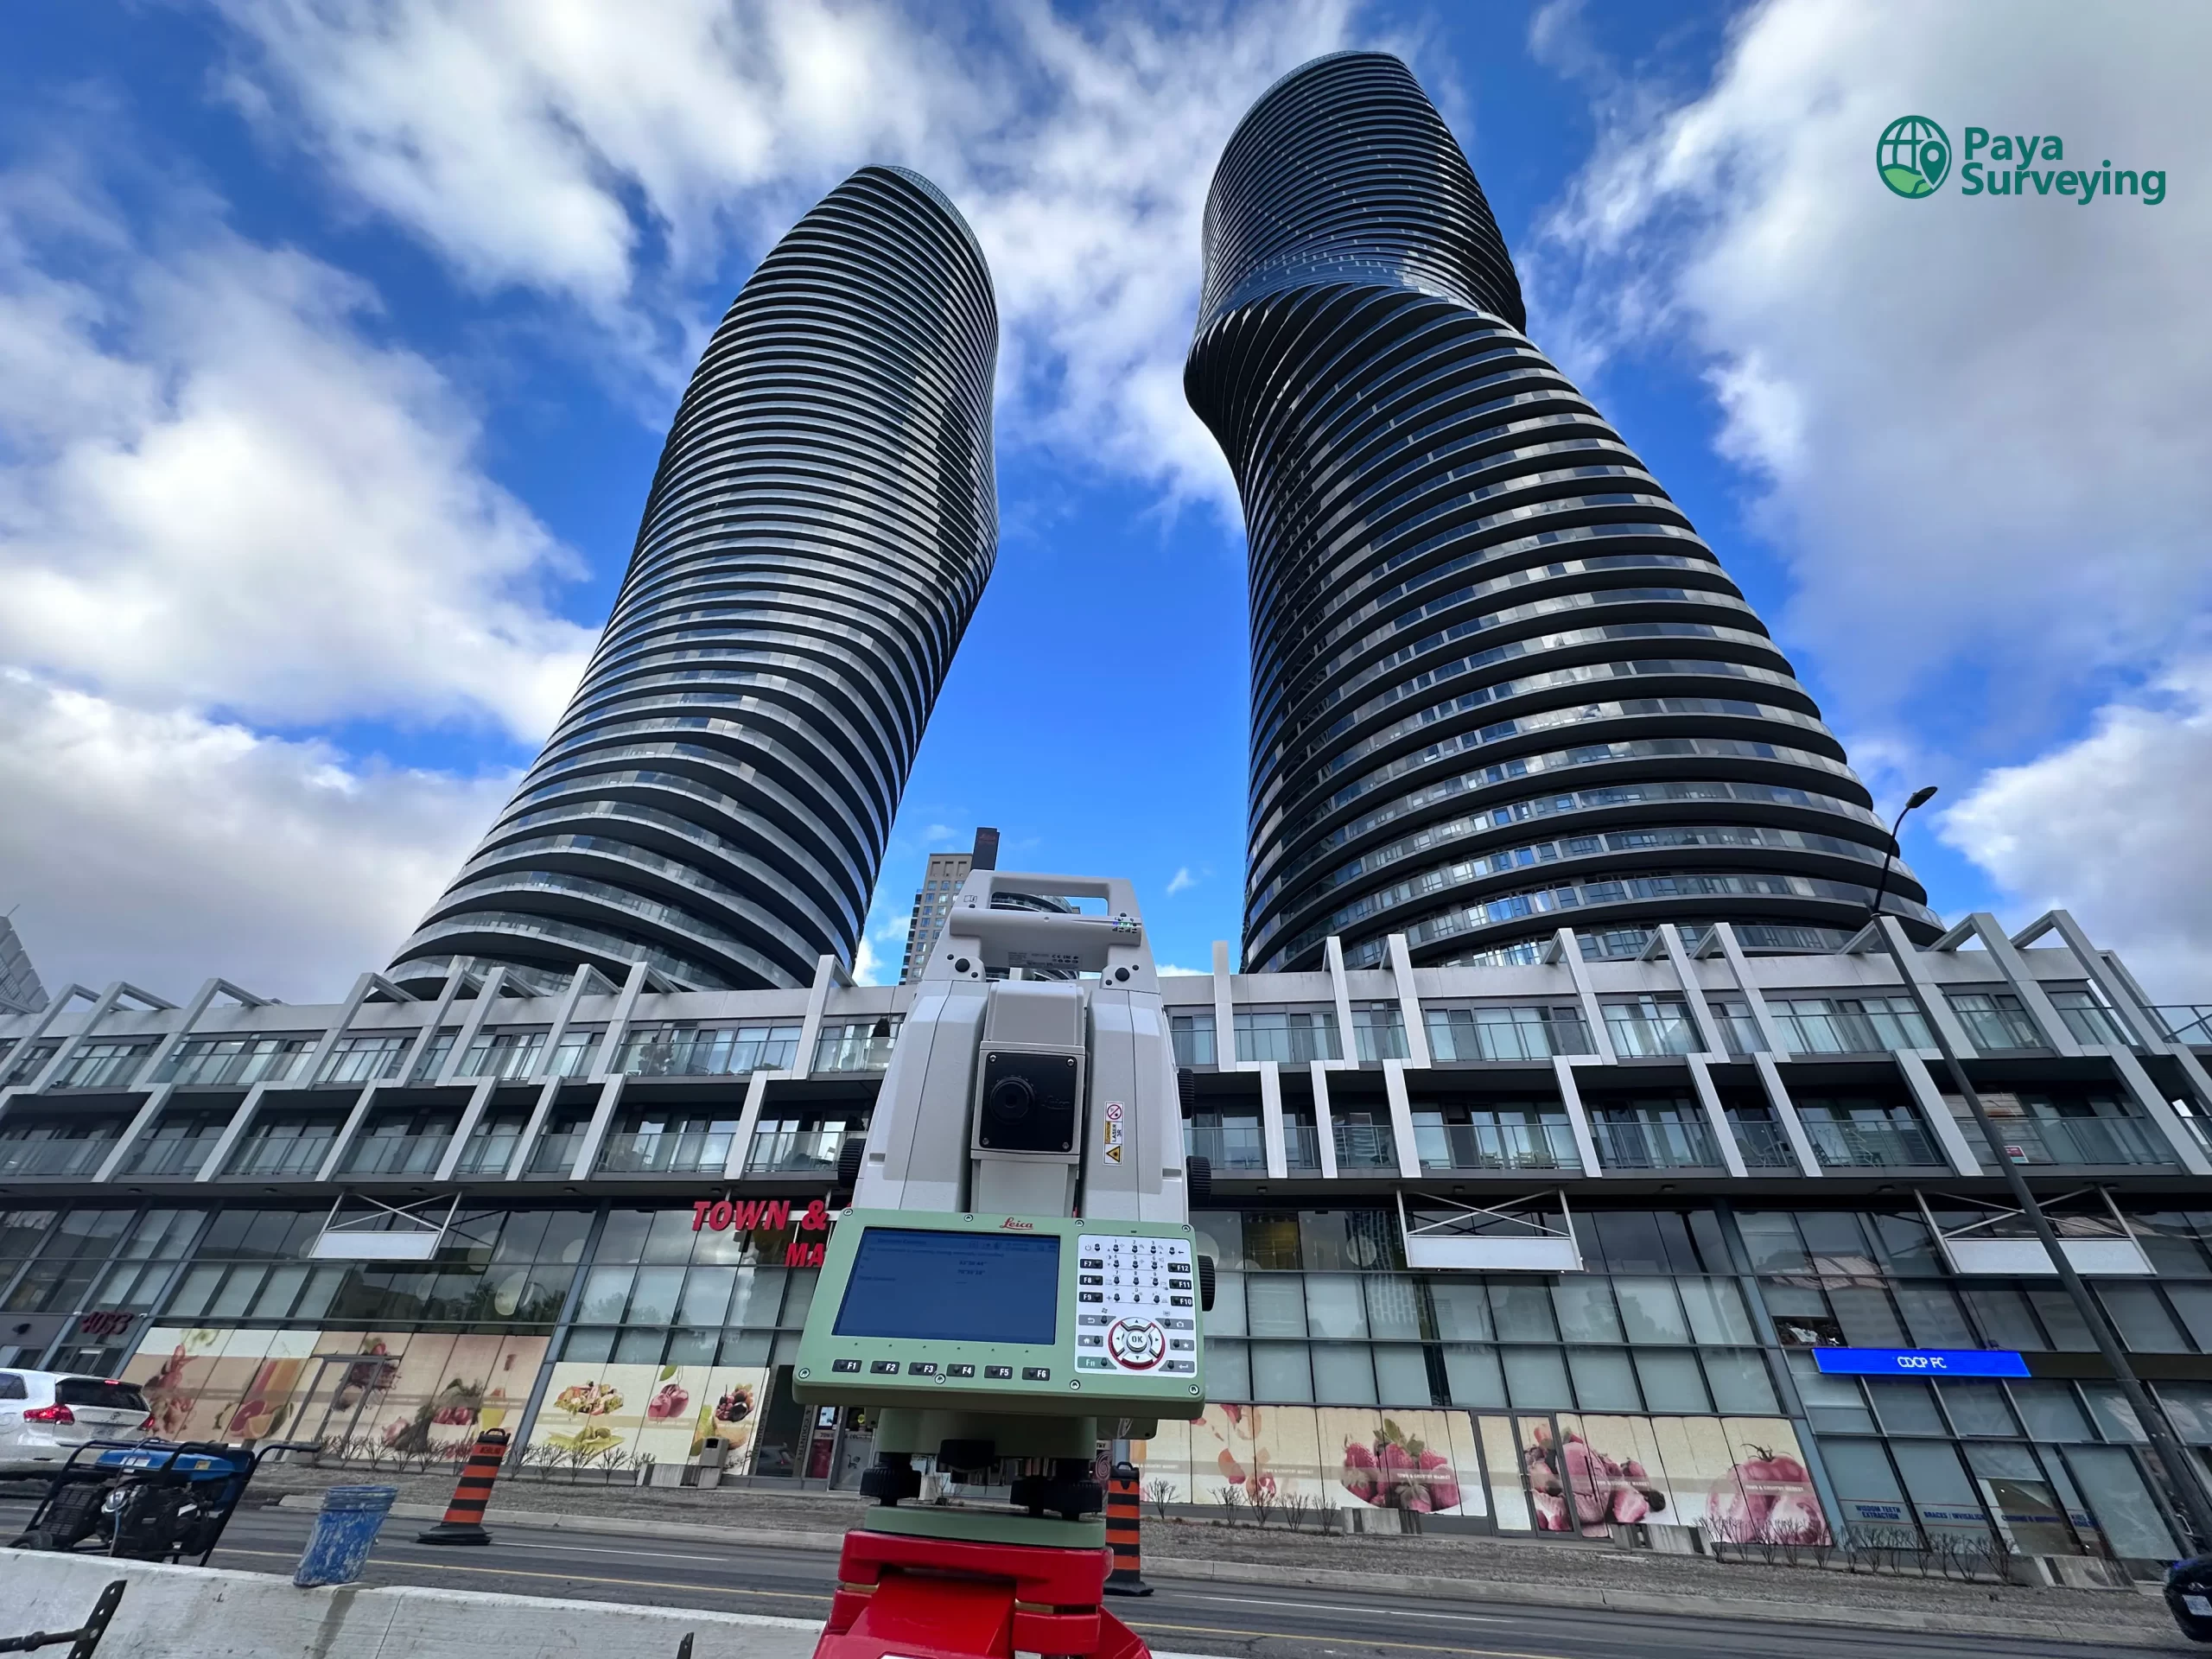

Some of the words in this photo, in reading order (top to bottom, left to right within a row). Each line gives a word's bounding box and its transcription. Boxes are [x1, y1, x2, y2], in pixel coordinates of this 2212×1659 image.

[691, 1199, 791, 1231] TOWN
[801, 1199, 830, 1231] &
[999, 1217, 1034, 1230] Leica
[1085, 1358, 1096, 1367] Fn
[1897, 1356, 1928, 1368] CDCP
[1929, 1357, 1948, 1369] FC
[1037, 1370, 1046, 1378] F6
